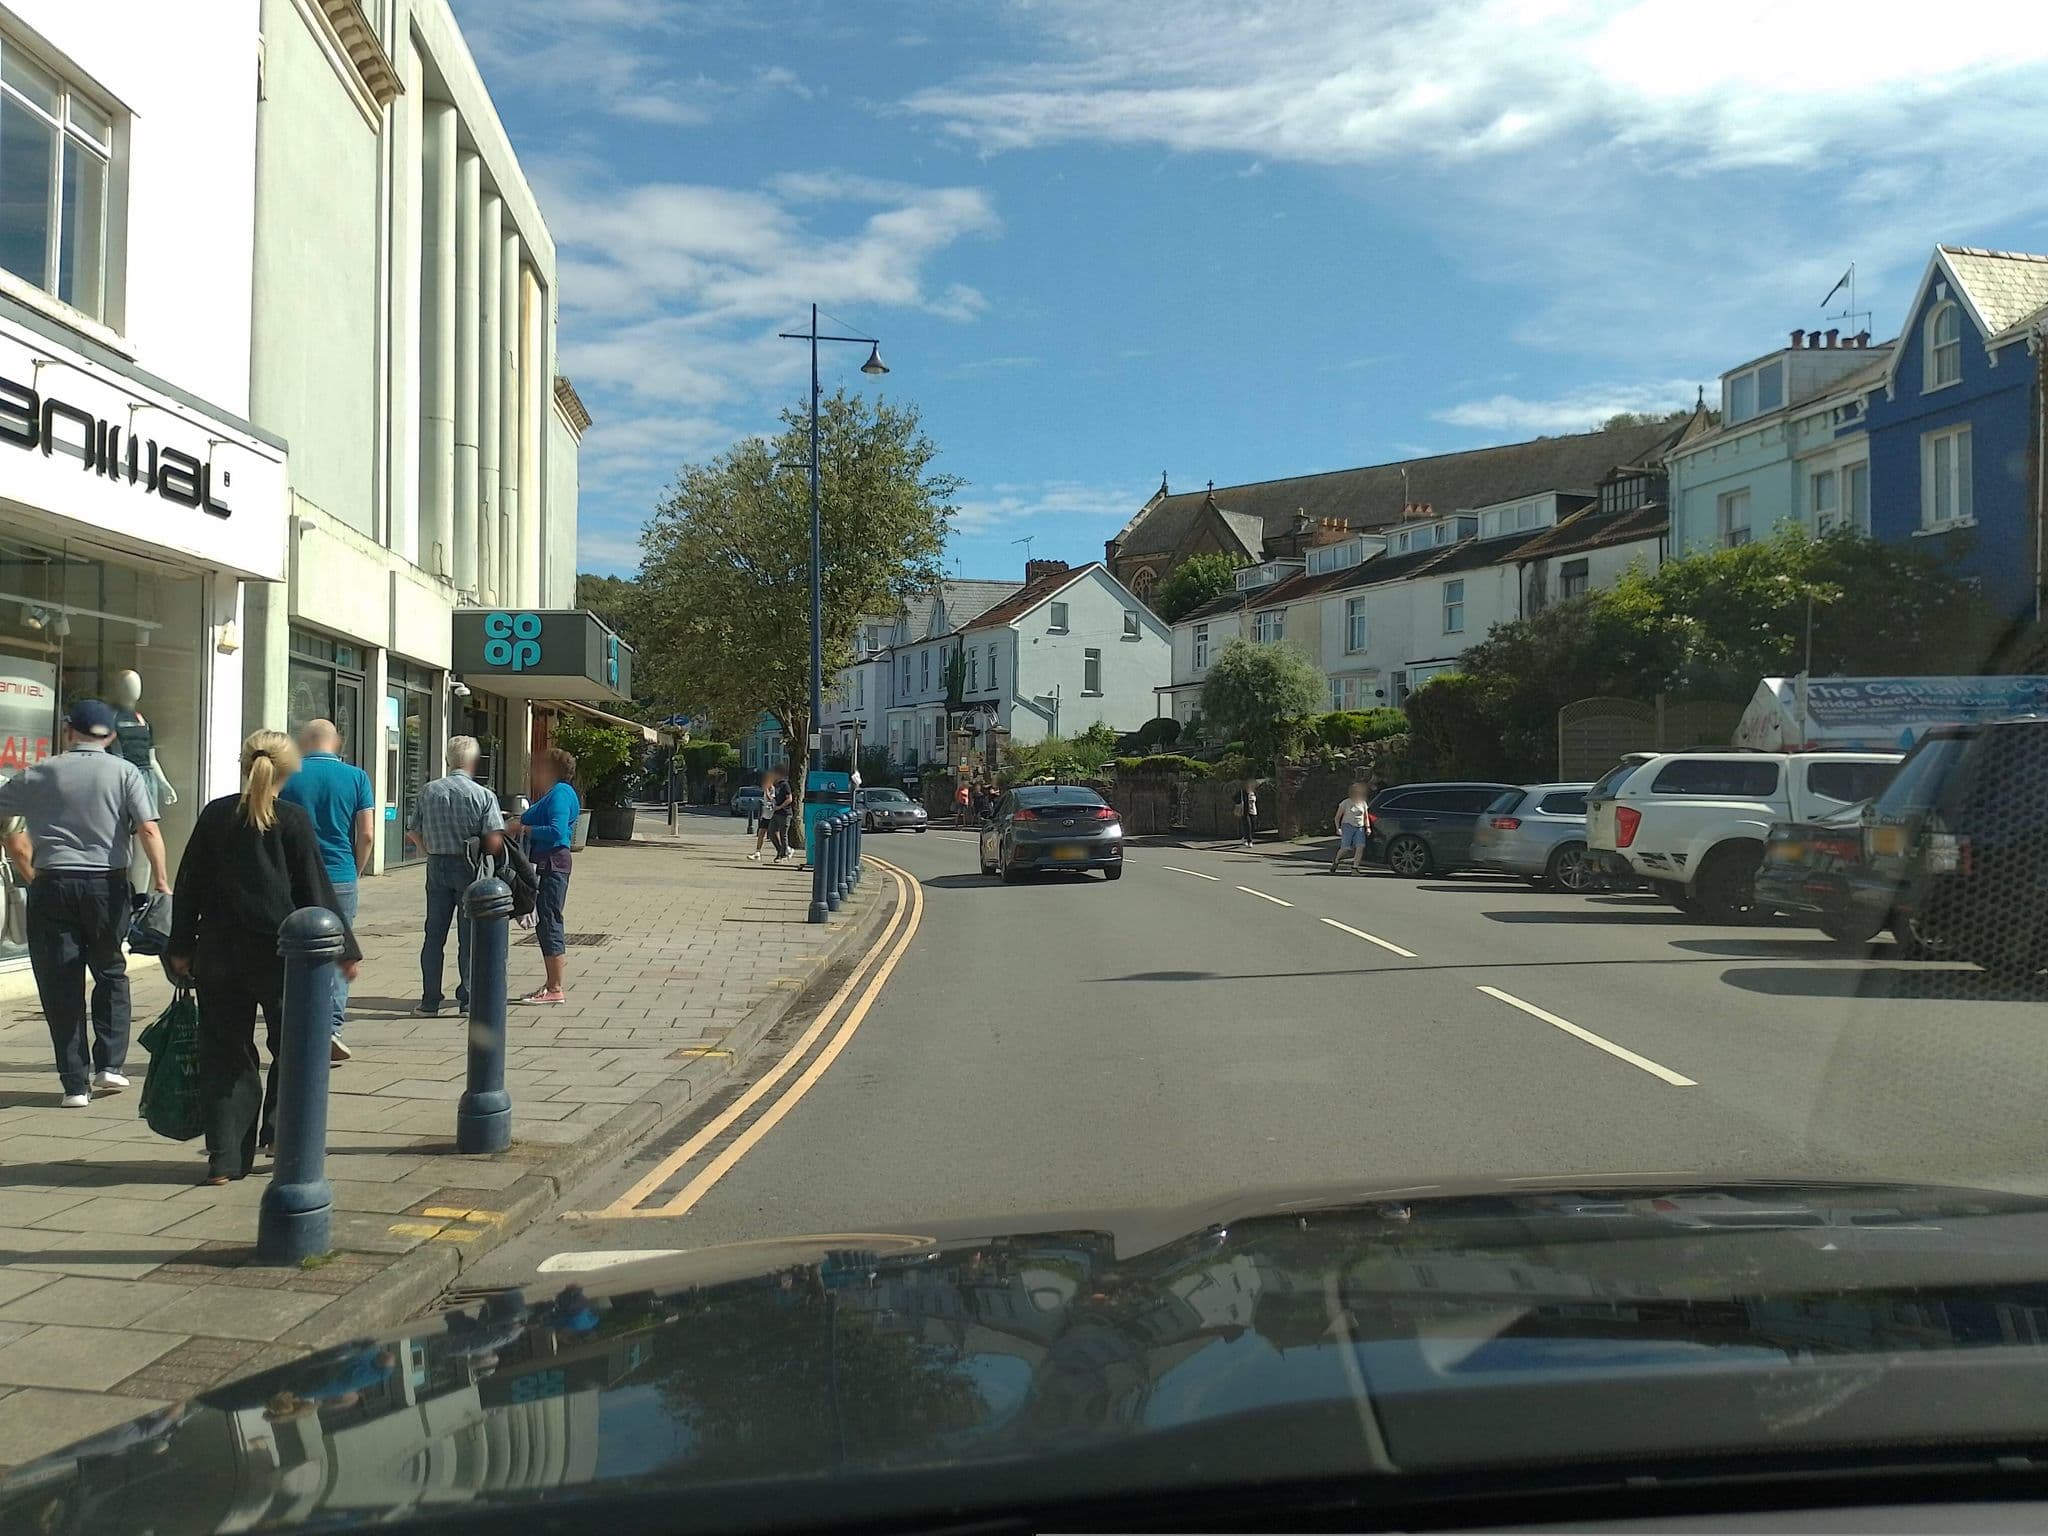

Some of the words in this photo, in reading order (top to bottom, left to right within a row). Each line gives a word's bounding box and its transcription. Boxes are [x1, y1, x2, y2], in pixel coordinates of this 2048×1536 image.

[1807, 684, 1859, 698] The
[1809, 699, 1867, 710] Bridge
[0, 736, 49, 770] ALE
